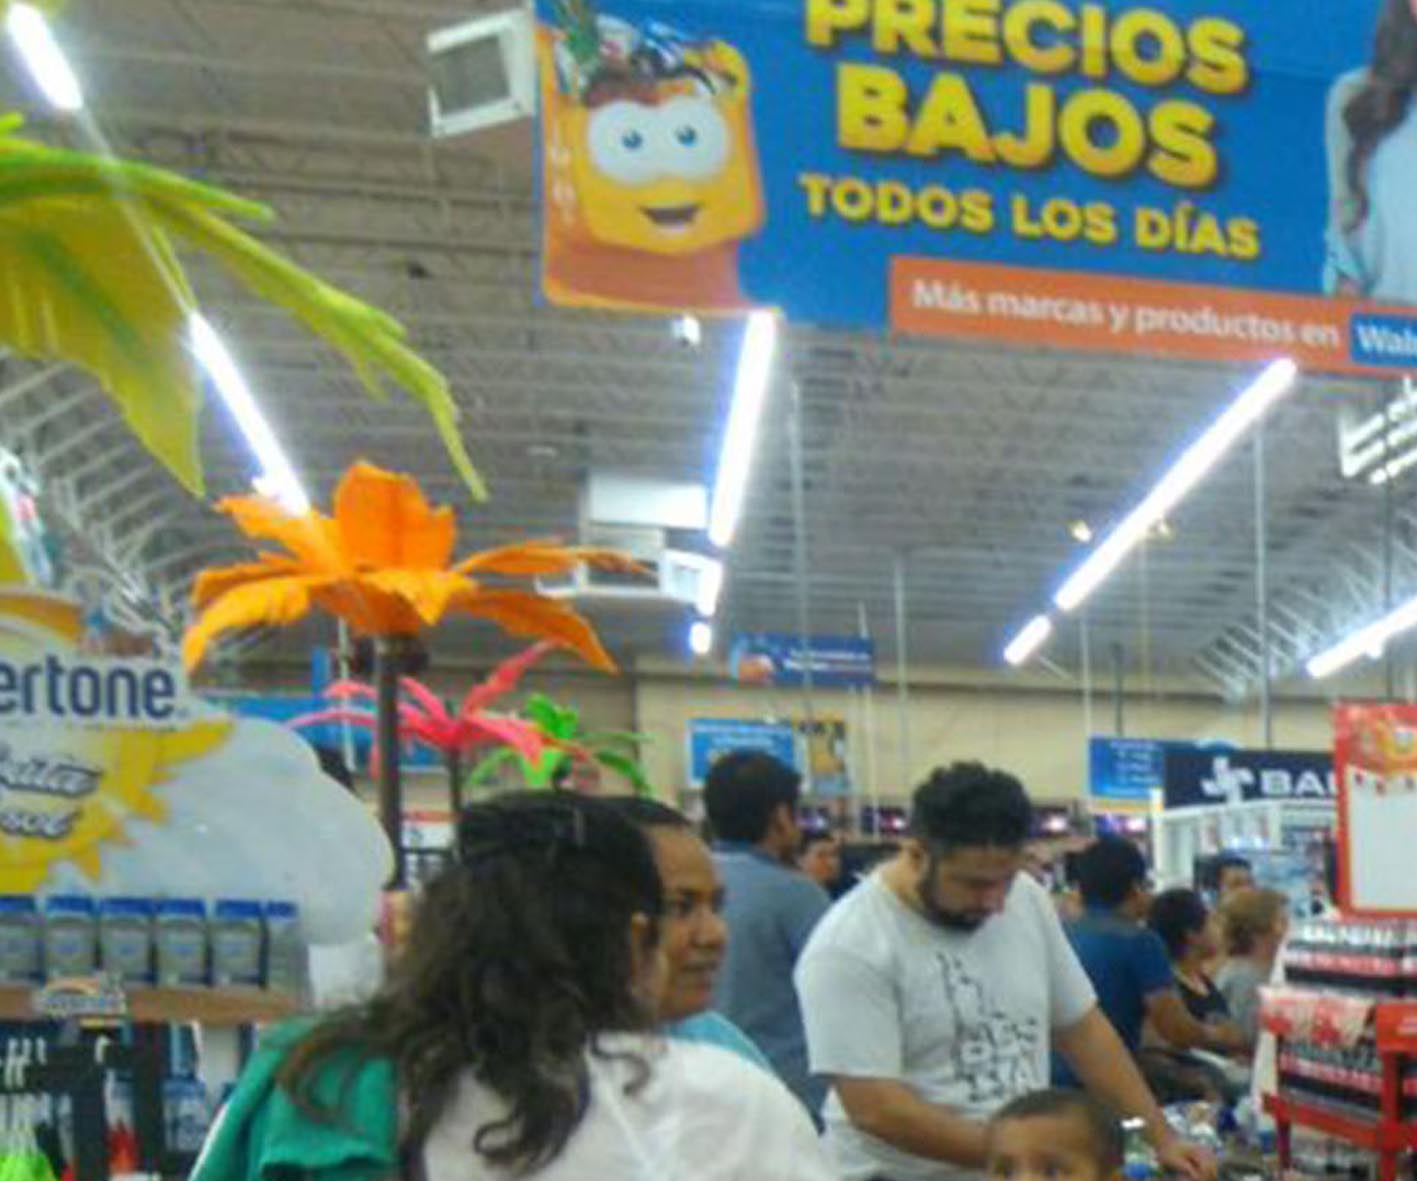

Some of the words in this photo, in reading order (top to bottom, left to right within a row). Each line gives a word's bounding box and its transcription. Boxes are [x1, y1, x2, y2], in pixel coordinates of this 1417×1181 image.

[805, 0, 1248, 93] PRECIOS
[837, 62, 1218, 188] BAJOS
[800, 174, 994, 231] TODOS
[1012, 196, 1116, 242] LOS
[1136, 204, 1259, 259] DÍAS
[912, 279, 979, 314] Más
[985, 291, 1103, 326] marcas
[1108, 305, 1130, 333] y
[1135, 304, 1294, 345] productos
[1301, 324, 1339, 348] en
[1260, 768, 1336, 797] BA
